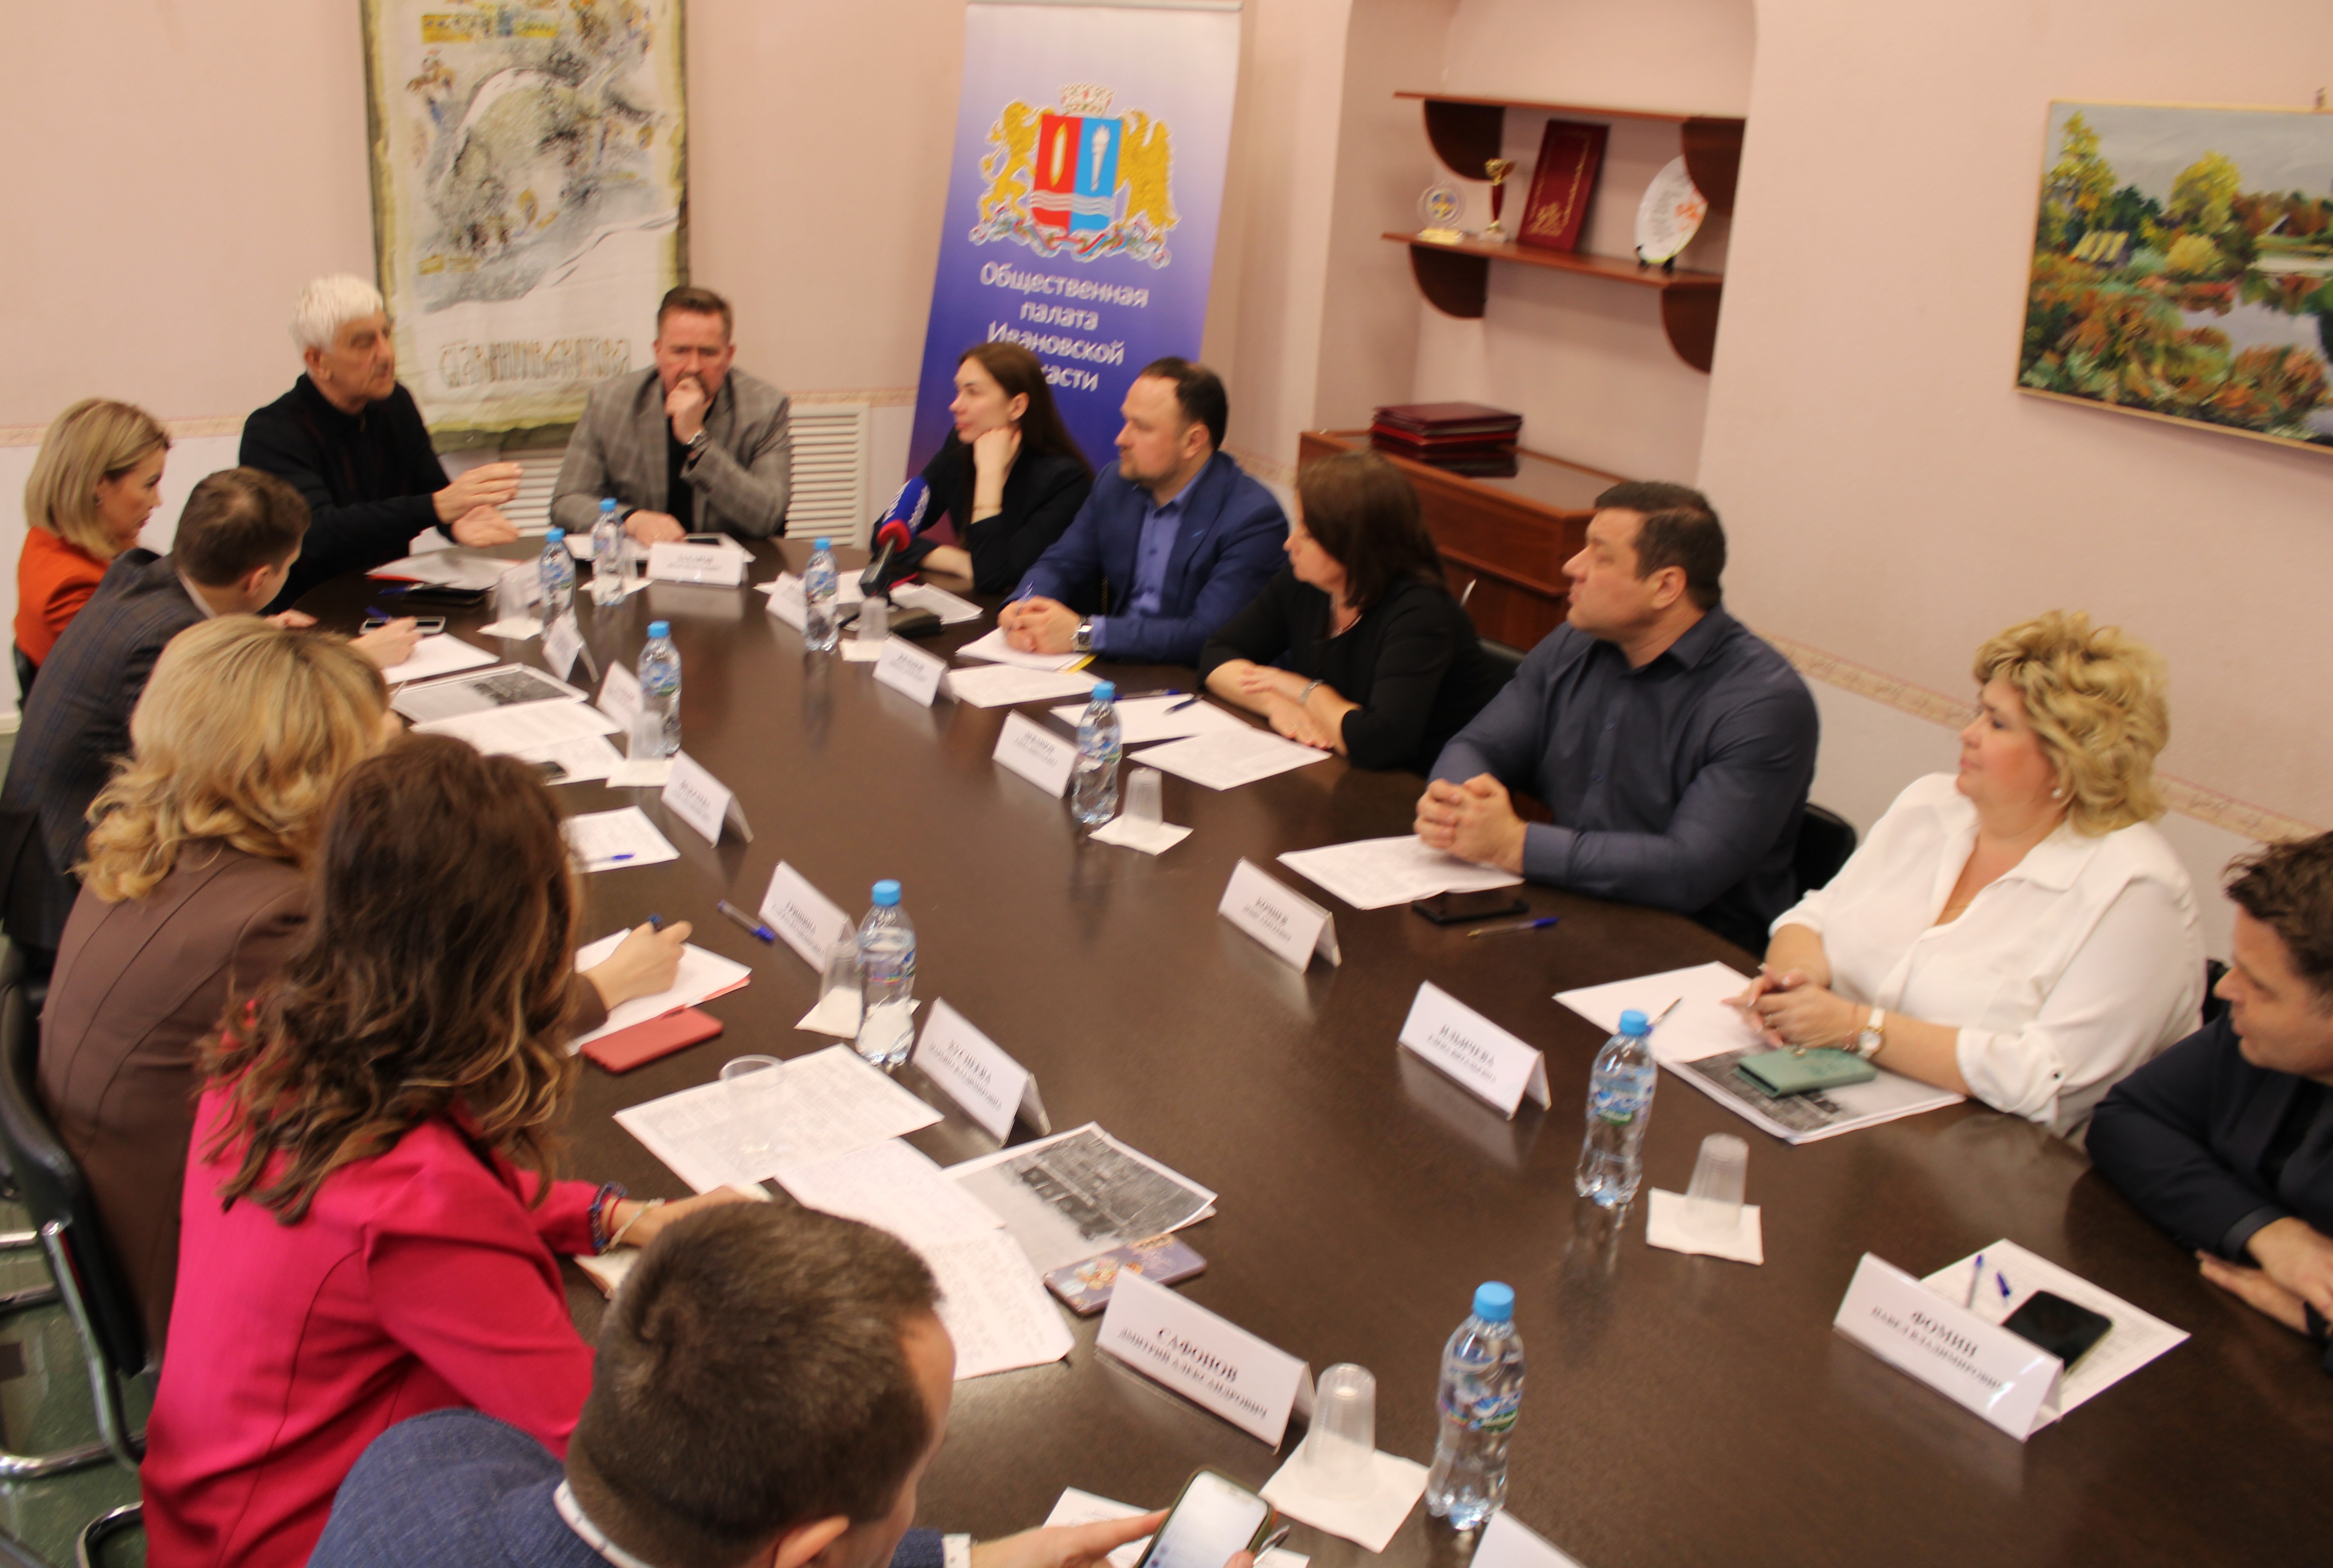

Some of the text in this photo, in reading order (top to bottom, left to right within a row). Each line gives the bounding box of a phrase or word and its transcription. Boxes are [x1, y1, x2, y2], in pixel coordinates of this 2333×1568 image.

[980, 260, 1149, 308] Общественная
[1019, 301, 1100, 331] палата
[987, 320, 1125, 366] Ивановской
[1041, 363, 1100, 392] асти
[1438, 1024, 1496, 1067] ИЛЬИЧЕВА
[1871, 1306, 1909, 1335] ПАВЕЛ
[1909, 1309, 1979, 1358] ФОМИН
[1117, 1326, 1270, 1420] ДМИТРИЙ АЛЕКСАНДРОВИЧ
[1156, 1326, 1240, 1383] САФОНОВ
